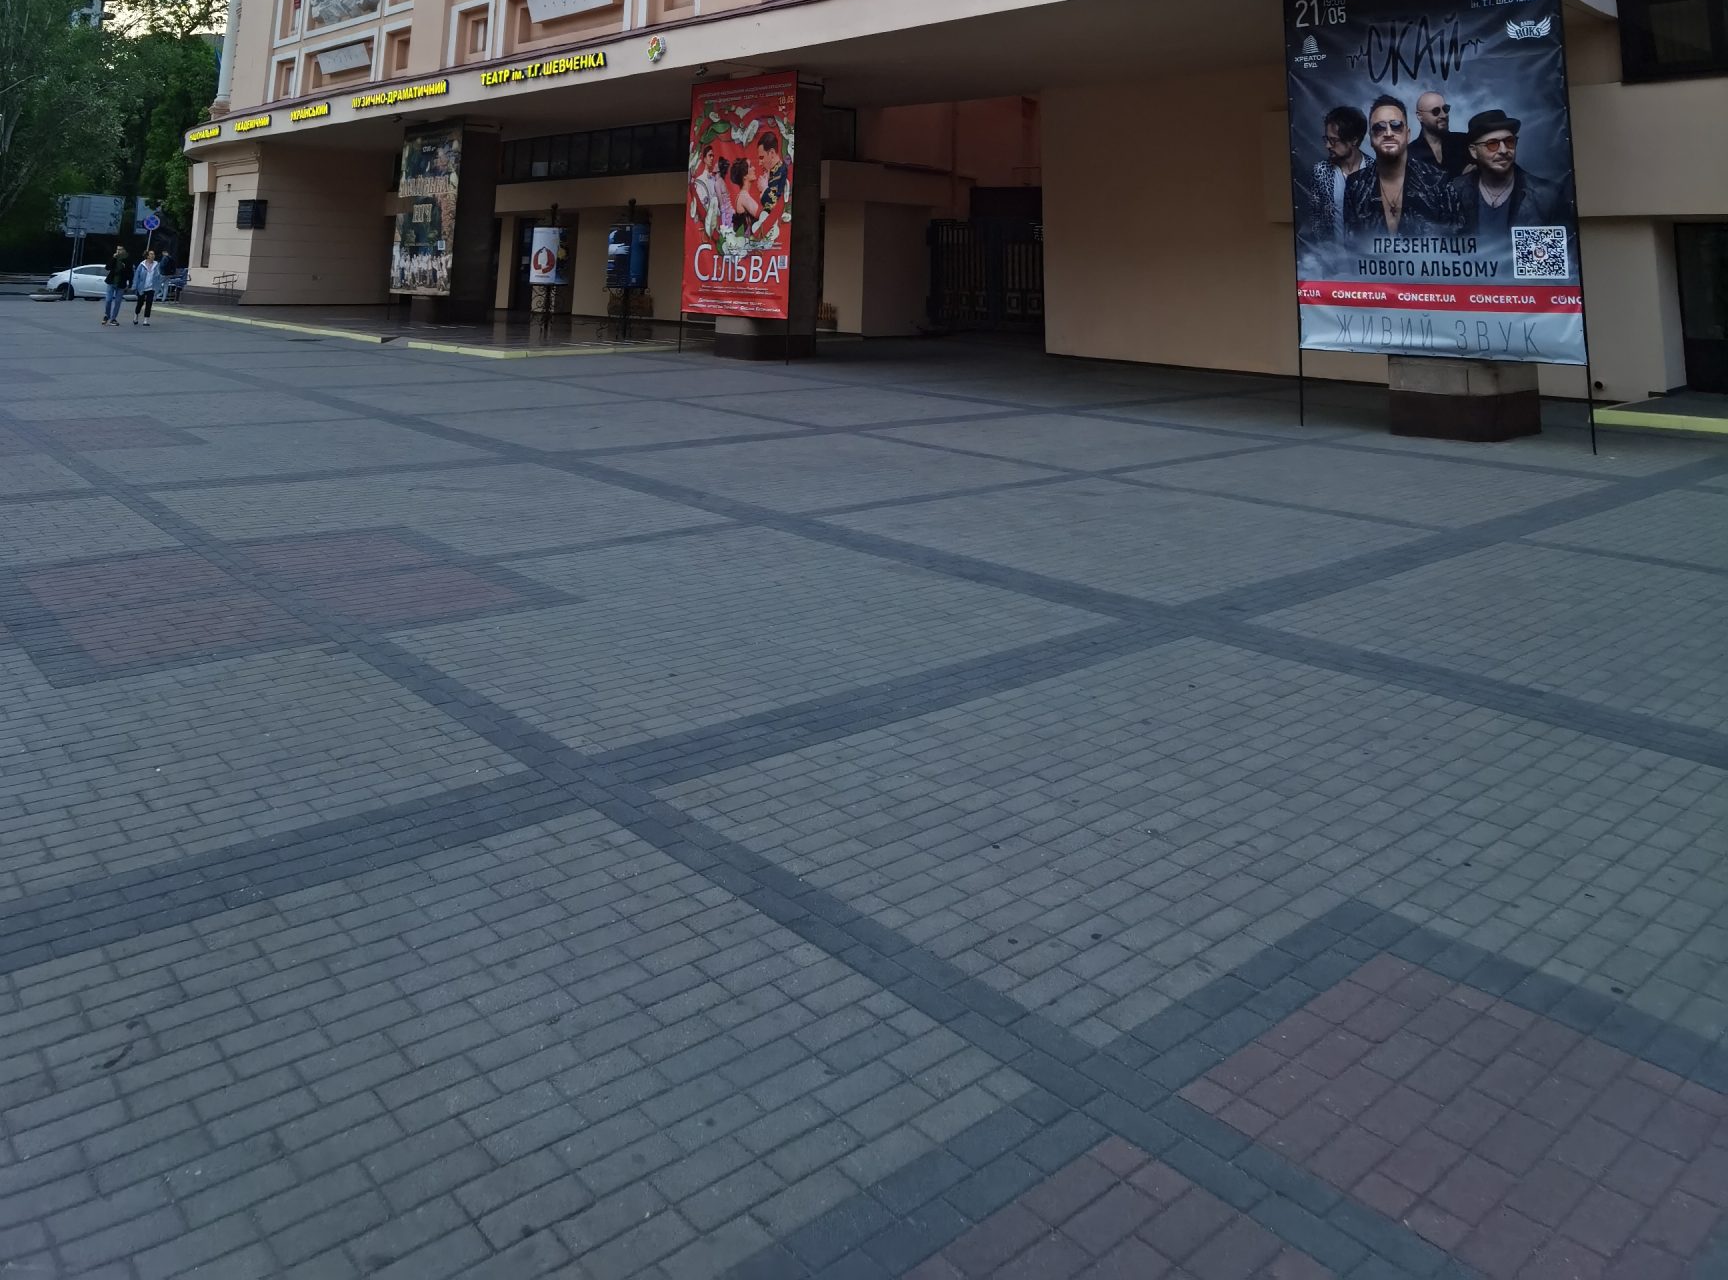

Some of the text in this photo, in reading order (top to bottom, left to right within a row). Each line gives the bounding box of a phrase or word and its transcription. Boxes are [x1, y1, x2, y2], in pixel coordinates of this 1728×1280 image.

[1515, 26, 1542, 39] ROKS
[1367, 12, 1462, 86] СКАЙ
[352, 80, 447, 108] МУЗИЧНО-ДРАМАТИЧНИЙ
[480, 69, 509, 86] ТЕАТР
[511, 70, 524, 81] ім.
[543, 52, 605, 75] ШЕВЧЕНКА
[1373, 237, 1477, 256] ПРЕЗЕНТАЦІЯ
[1358, 260, 1498, 277] НОВОГО АЛЬБОМУ
[1331, 289, 1387, 299] CONCERT.UA
[1397, 292, 1456, 302] CONCERT.UA
[1469, 294, 1536, 304] CONCERT.UA
[1336, 313, 1540, 353] ЖИВИЙ ЗВУК
